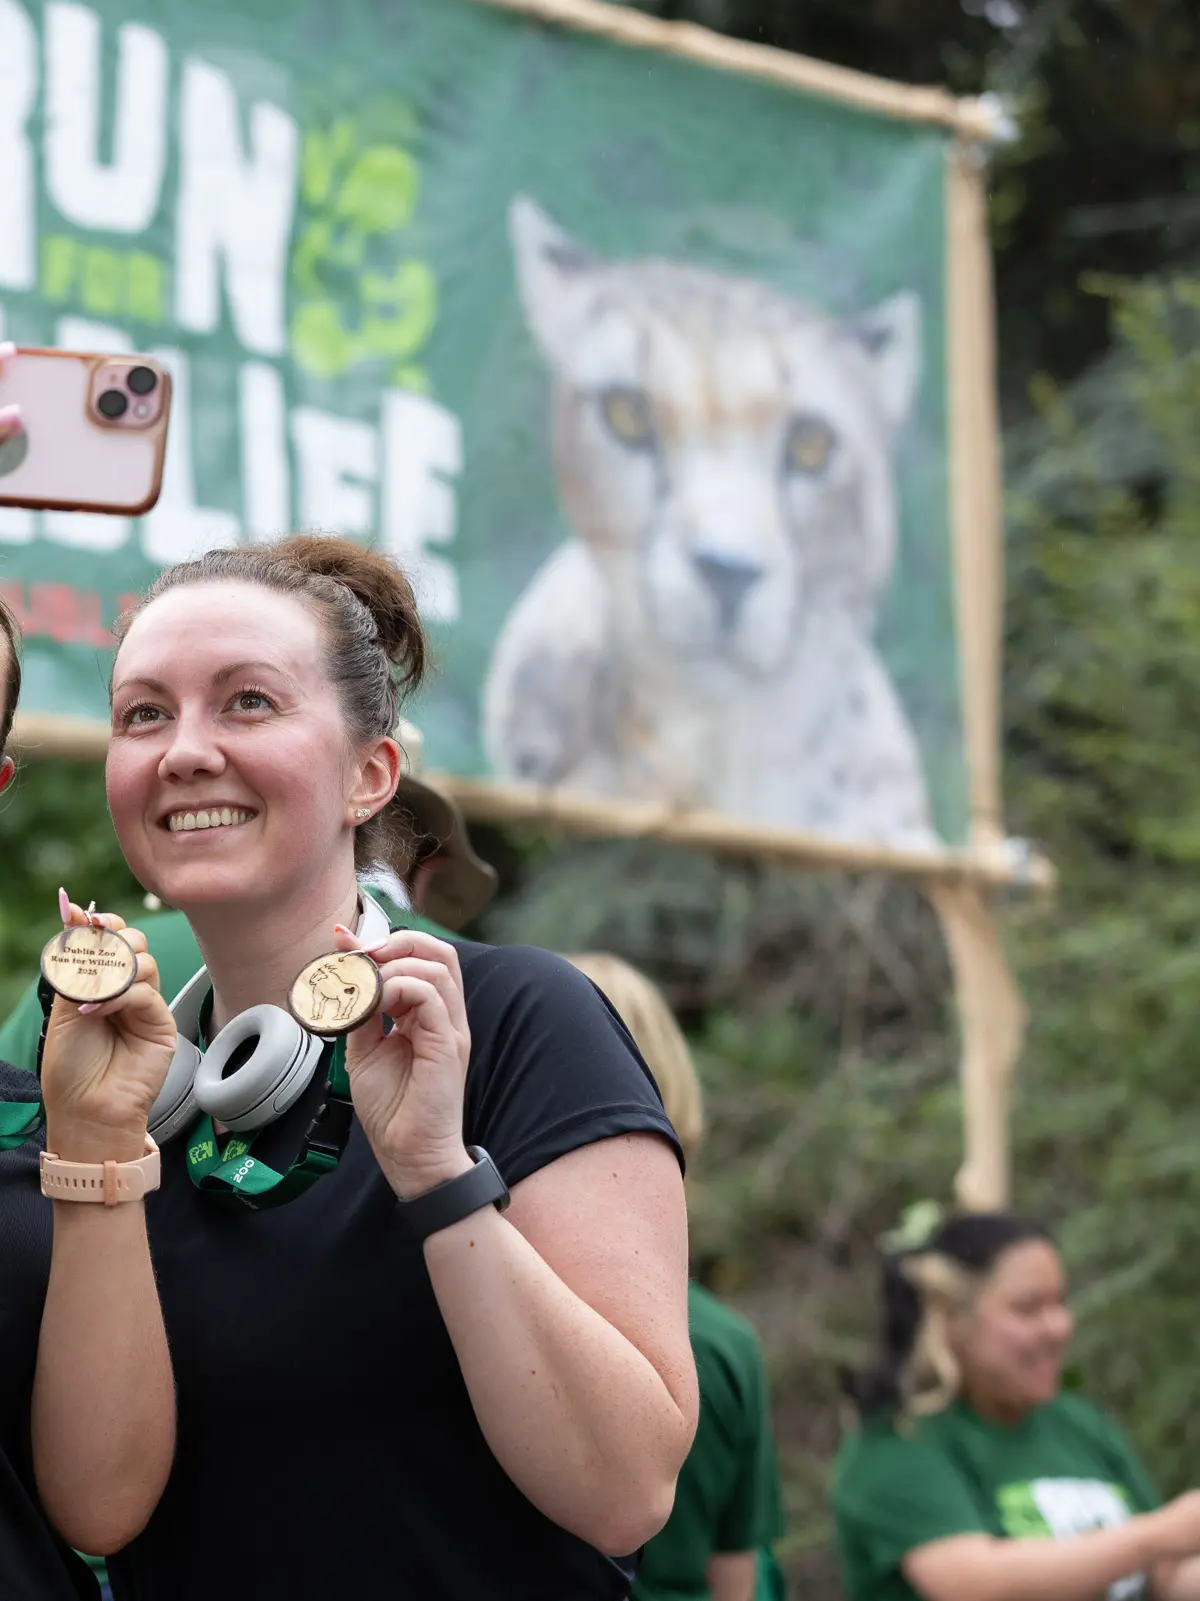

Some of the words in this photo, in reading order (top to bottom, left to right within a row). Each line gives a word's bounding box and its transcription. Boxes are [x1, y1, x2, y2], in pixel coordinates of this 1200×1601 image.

[63, 946, 95, 956] Dublin
[98, 949, 116, 957] Zoo
[51, 955, 70, 963] Run
[88, 958, 127, 967] Wildlife
[77, 967, 98, 976] 2025
